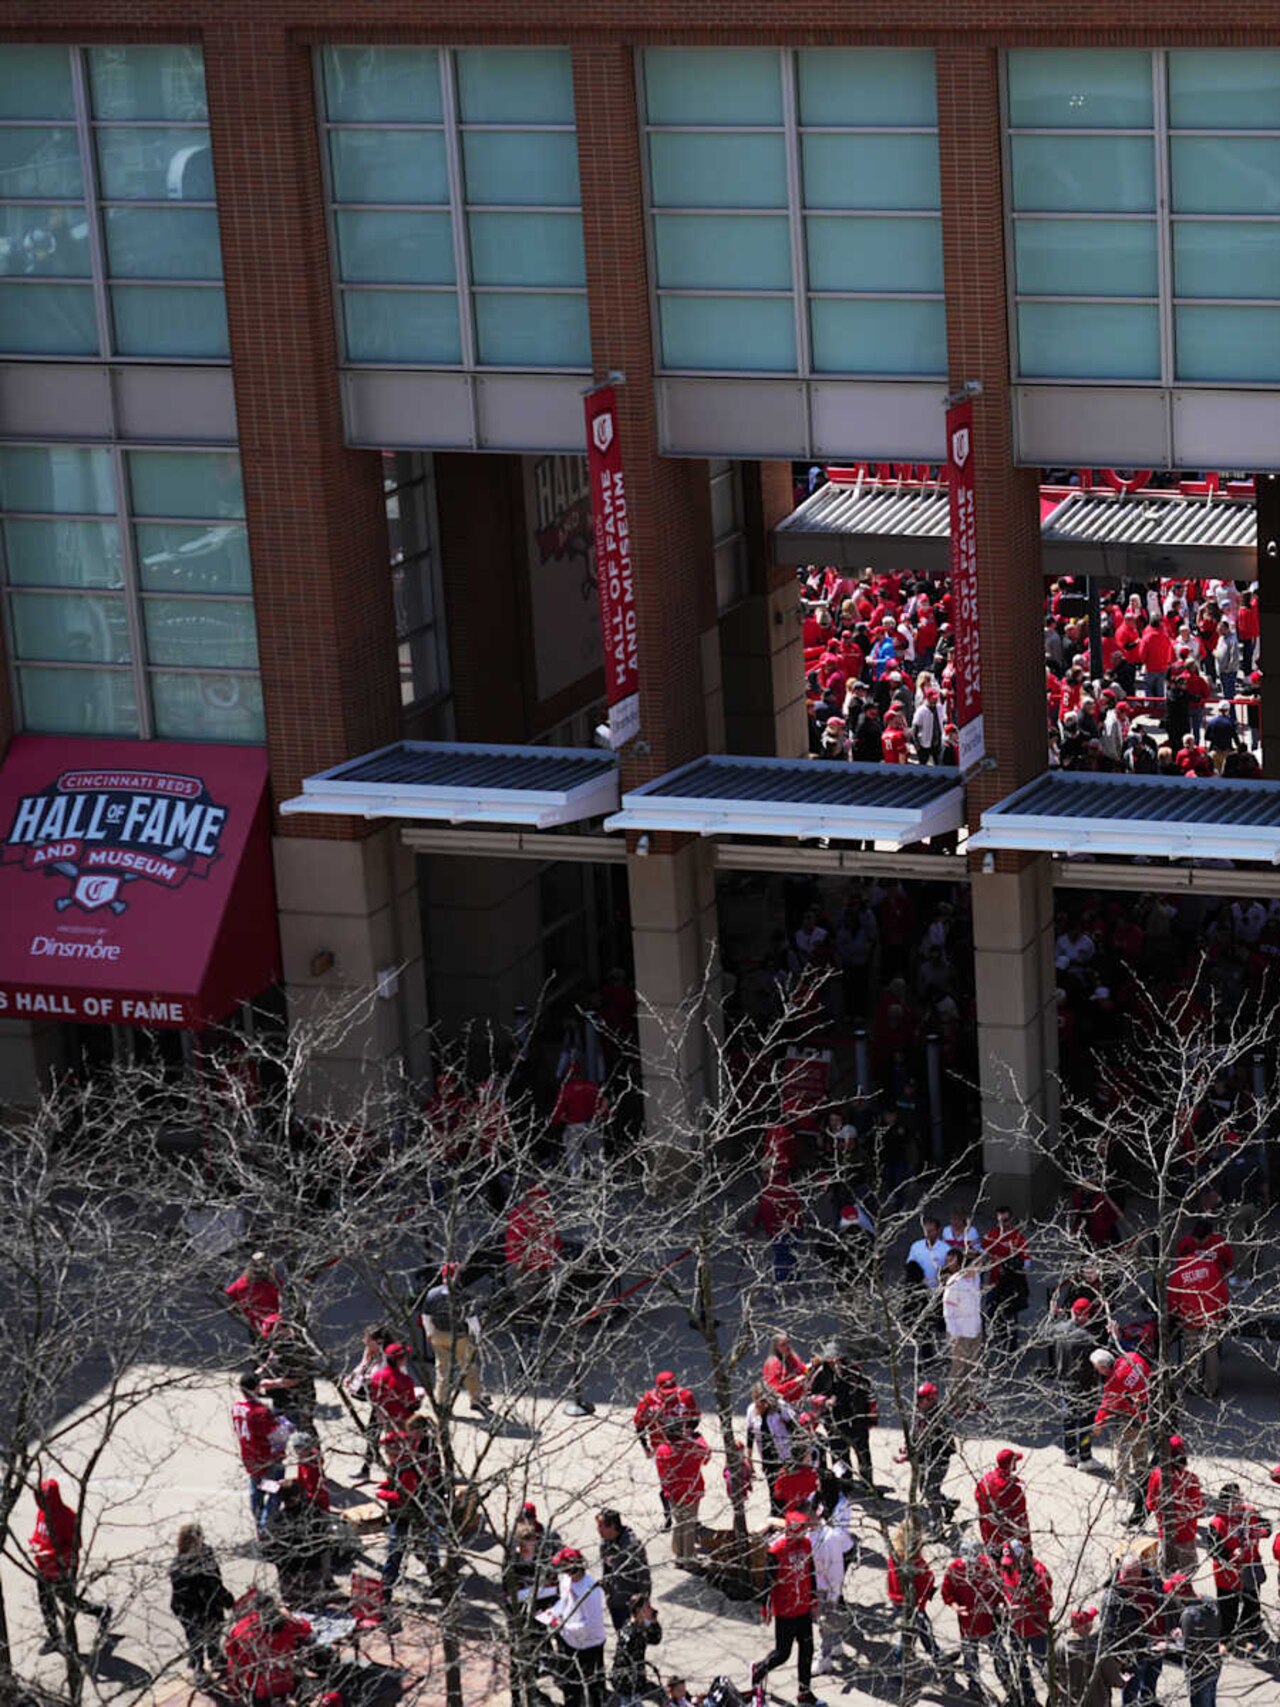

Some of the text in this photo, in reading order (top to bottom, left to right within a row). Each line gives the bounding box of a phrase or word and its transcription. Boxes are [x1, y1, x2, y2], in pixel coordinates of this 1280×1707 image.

[601, 470, 626, 685] HALL OF FAME
[614, 472, 638, 670] AND MUSEUM
[967, 489, 981, 692] AND MUSEUM
[957, 486, 972, 706] HALL OF FAME
[66, 776, 194, 794] CINCINNATI REDS
[9, 795, 225, 856] HALL OF FAME
[34, 844, 176, 880] AND MUSEUM
[30, 936, 120, 960] Dinsmore
[16, 992, 76, 1014] HALL
[84, 997, 113, 1016] OF
[122, 1000, 184, 1022] FAME
[1182, 1268, 1208, 1284] SECURITY
